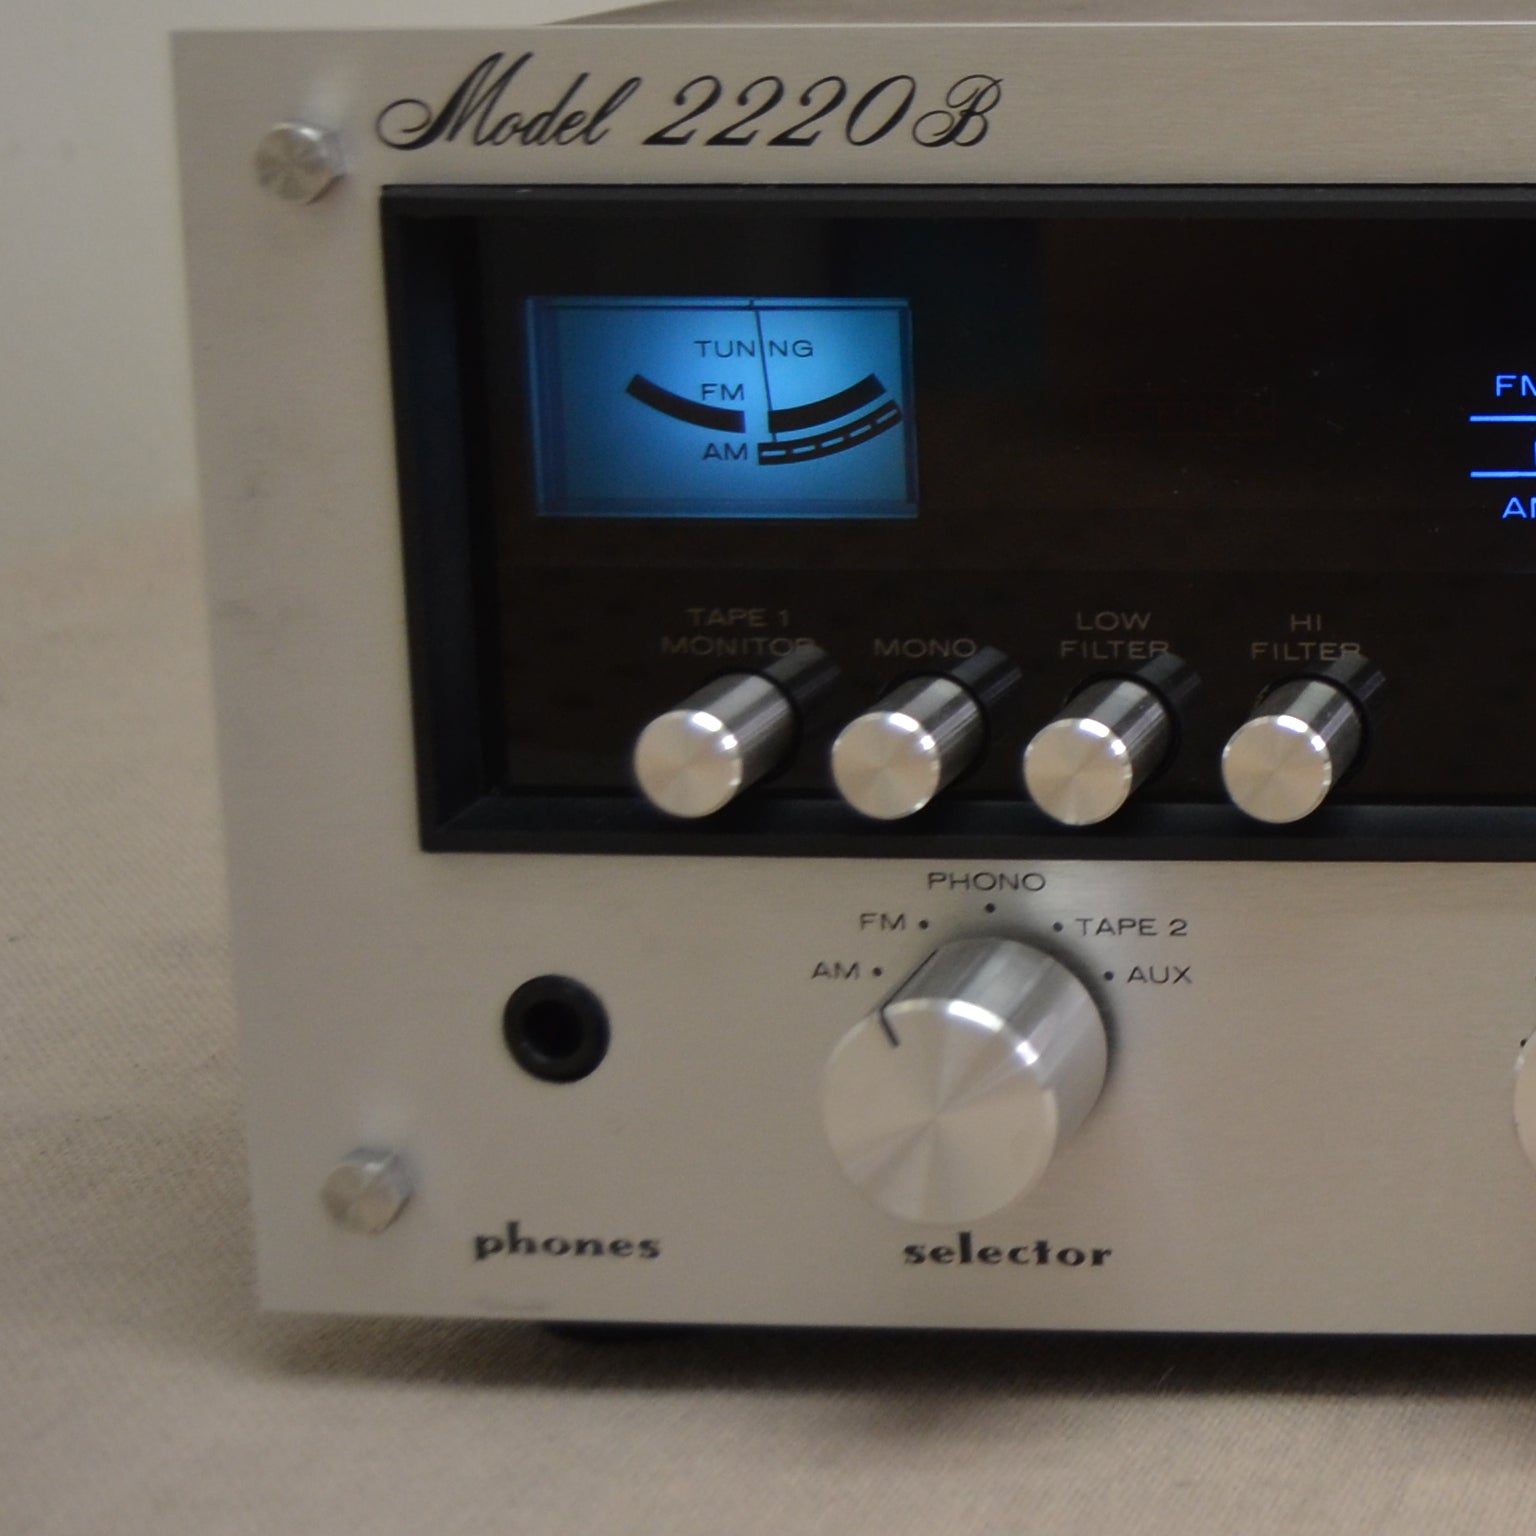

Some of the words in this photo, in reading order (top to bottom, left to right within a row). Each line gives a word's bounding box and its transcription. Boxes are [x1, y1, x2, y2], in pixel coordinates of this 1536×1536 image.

[375, 51, 642, 150] Model
[642, 74, 1003, 148] 2220B
[693, 339, 814, 359] TUNNG
[700, 383, 745, 402] FM
[703, 443, 749, 462] AM
[685, 608, 767, 627] TAPE
[777, 608, 789, 627] 1
[1076, 611, 1151, 632] LOW
[1290, 614, 1321, 633] HI
[874, 638, 977, 658] MONO
[1060, 640, 1170, 660] FILTER
[1251, 642, 1361, 662] FILTER
[927, 871, 1047, 891] PHONO
[860, 913, 906, 932] FM
[1075, 918, 1158, 937] TAPE
[1168, 918, 1188, 937] 2
[811, 962, 860, 979] AM
[1127, 966, 1193, 984] AUX
[473, 1221, 661, 1261] phones
[902, 1231, 1113, 1267] selector
